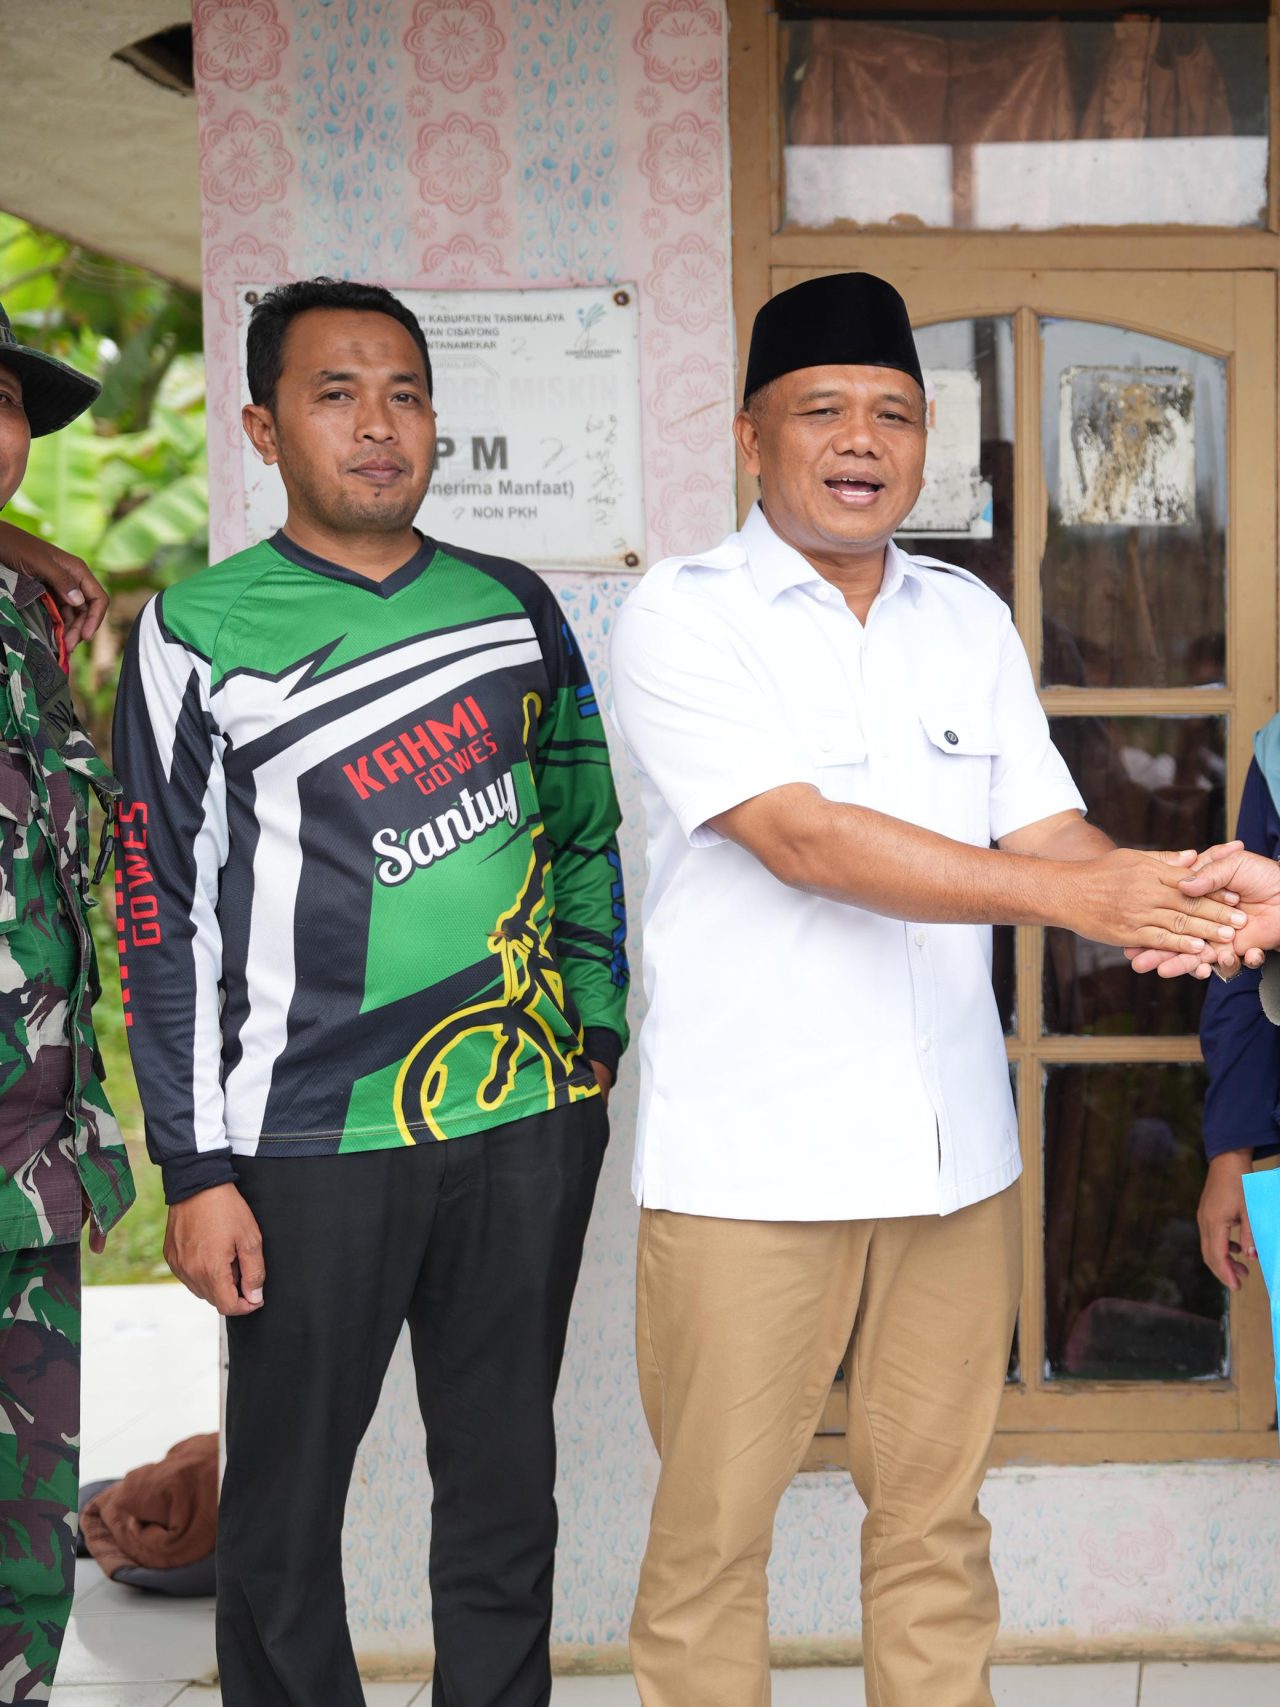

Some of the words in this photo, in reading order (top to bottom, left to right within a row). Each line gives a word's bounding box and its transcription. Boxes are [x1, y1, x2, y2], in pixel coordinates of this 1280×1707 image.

[428, 313, 491, 323] KABUPATEN
[494, 313, 565, 323] TASIKMALAYA
[446, 327, 500, 337] CISAYONG
[427, 340, 497, 350] NTANAMEKAR
[428, 479, 493, 495] nerima
[498, 478, 575, 500] Manfaat)
[472, 506, 504, 519] NON
[508, 506, 538, 519] PKH
[341, 695, 489, 801] KAHMI
[414, 732, 498, 795] GOWES
[371, 770, 519, 884] Santuy
[118, 800, 162, 948] GOWES
